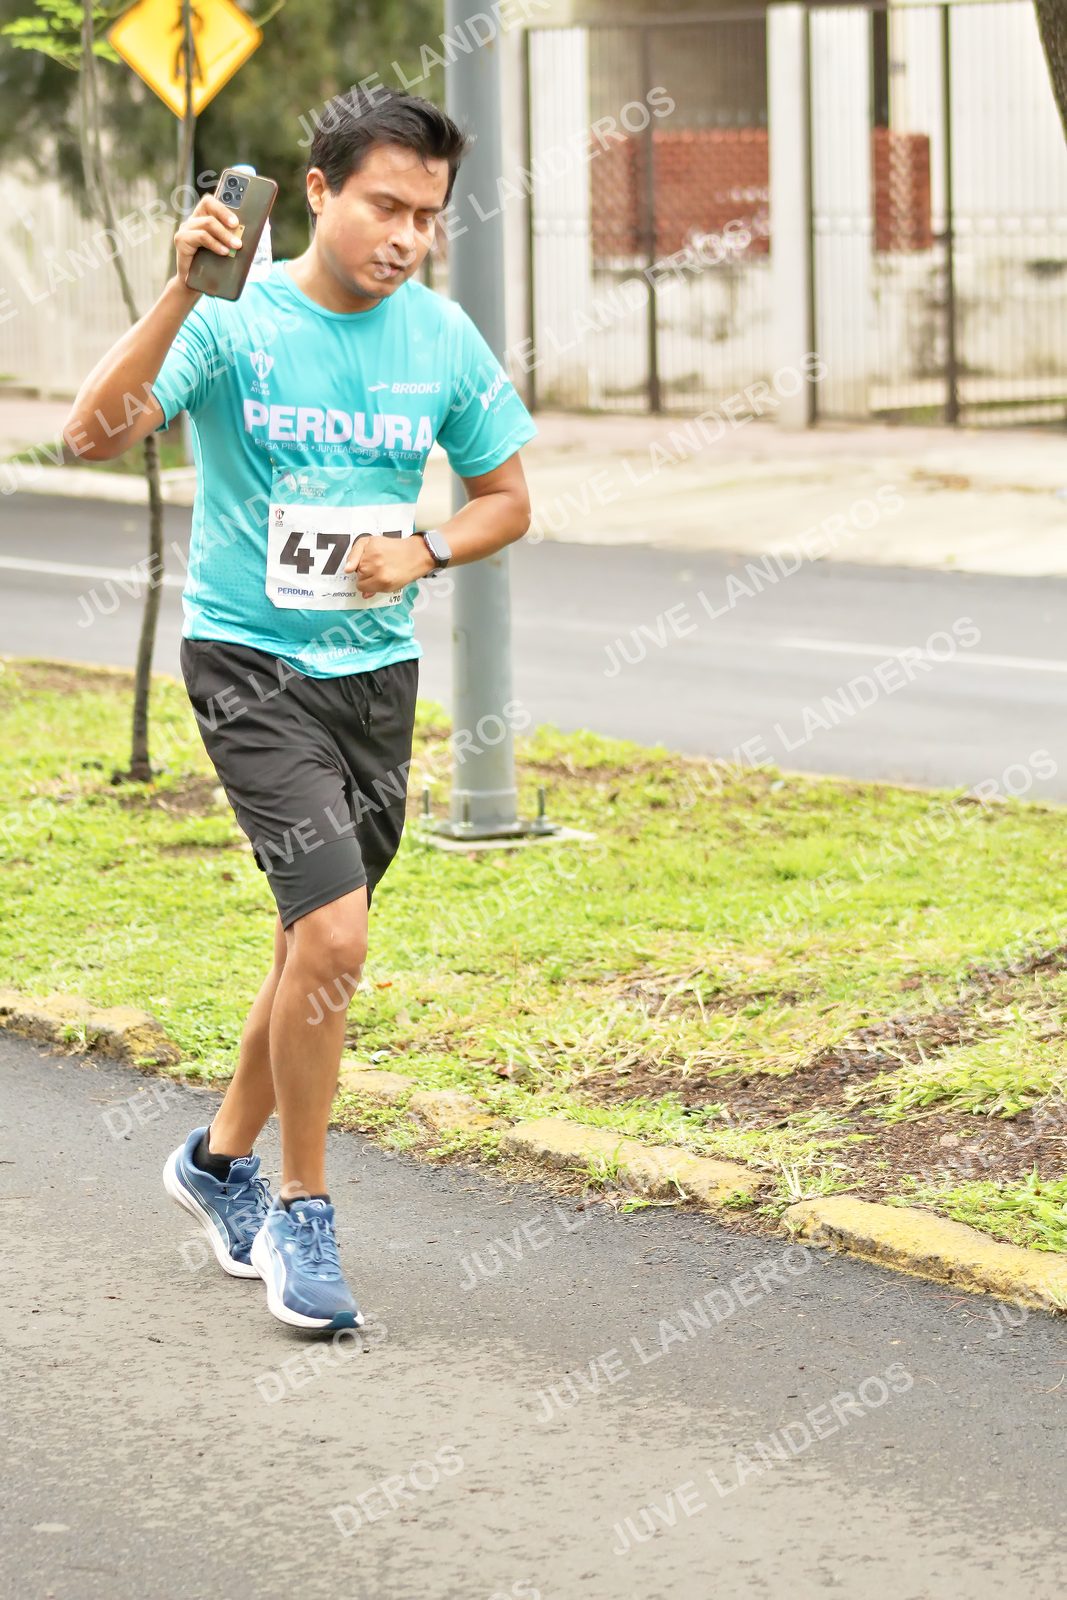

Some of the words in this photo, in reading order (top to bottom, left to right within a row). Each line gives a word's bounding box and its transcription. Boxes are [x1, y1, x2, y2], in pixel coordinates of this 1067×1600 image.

[391, 382, 440, 394] BROOKS
[243, 399, 433, 451] PERDURA
[281, 443, 309, 452] PISOS
[277, 587, 314, 597] PERDURA
